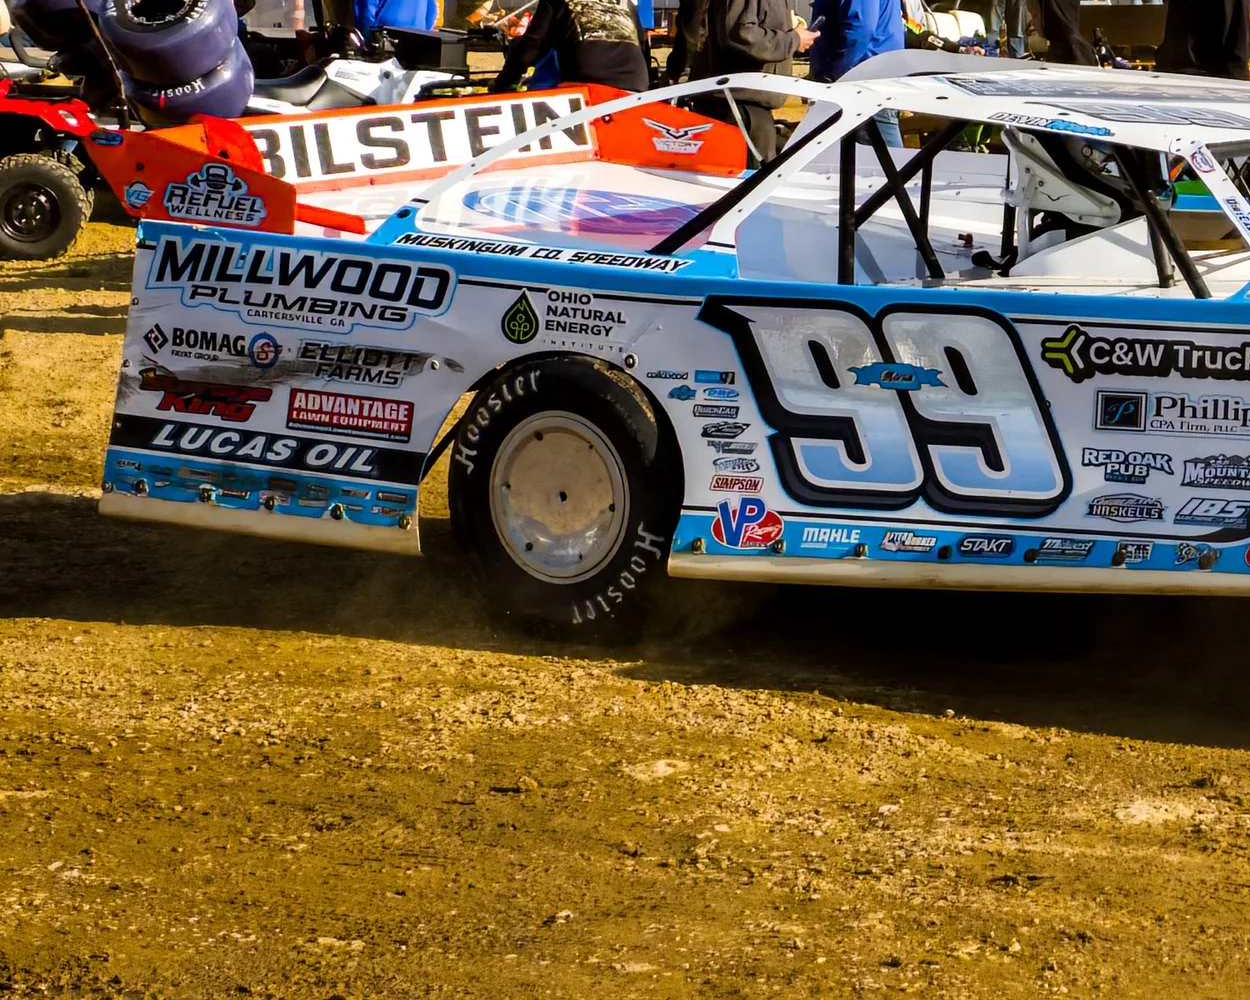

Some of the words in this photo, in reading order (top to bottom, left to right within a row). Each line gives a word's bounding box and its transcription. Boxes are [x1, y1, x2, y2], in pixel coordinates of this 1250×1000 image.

[252, 97, 589, 180] BILSTEIN
[168, 185, 261, 213] REFUEL
[171, 203, 256, 222] WELLNESS
[396, 233, 526, 258] MUSKINGUM
[530, 248, 562, 261] CO.
[568, 251, 690, 273] SPEEDWAY
[156, 240, 450, 309] MILLWOOD
[189, 284, 409, 323] PLUMBING
[547, 290, 592, 306] OHIO
[247, 309, 323, 325] CARTERSVILLE
[330, 317, 346, 328] GA
[546, 305, 627, 325] NATURAL
[171, 327, 246, 356] BOMAG
[544, 320, 613, 338] ENERGY
[543, 339, 624, 353] INSTITUTE
[1089, 341, 1165, 367] C&W
[316, 362, 402, 386] FARMS
[293, 392, 410, 421] ADVANTAGE
[715, 300, 1070, 506] 99
[292, 410, 330, 423] LAWN
[333, 415, 408, 432] EQUIPMENT
[1150, 419, 1175, 430] CPA
[152, 424, 300, 461] LUCAS
[303, 445, 379, 473] OIL
[1083, 448, 1125, 465] RED
[1128, 452, 1174, 475] OAK
[1106, 463, 1148, 476] PUB
[713, 477, 760, 491] SIMPSON
[718, 497, 766, 547] VP
[802, 528, 861, 543] MAHLE
